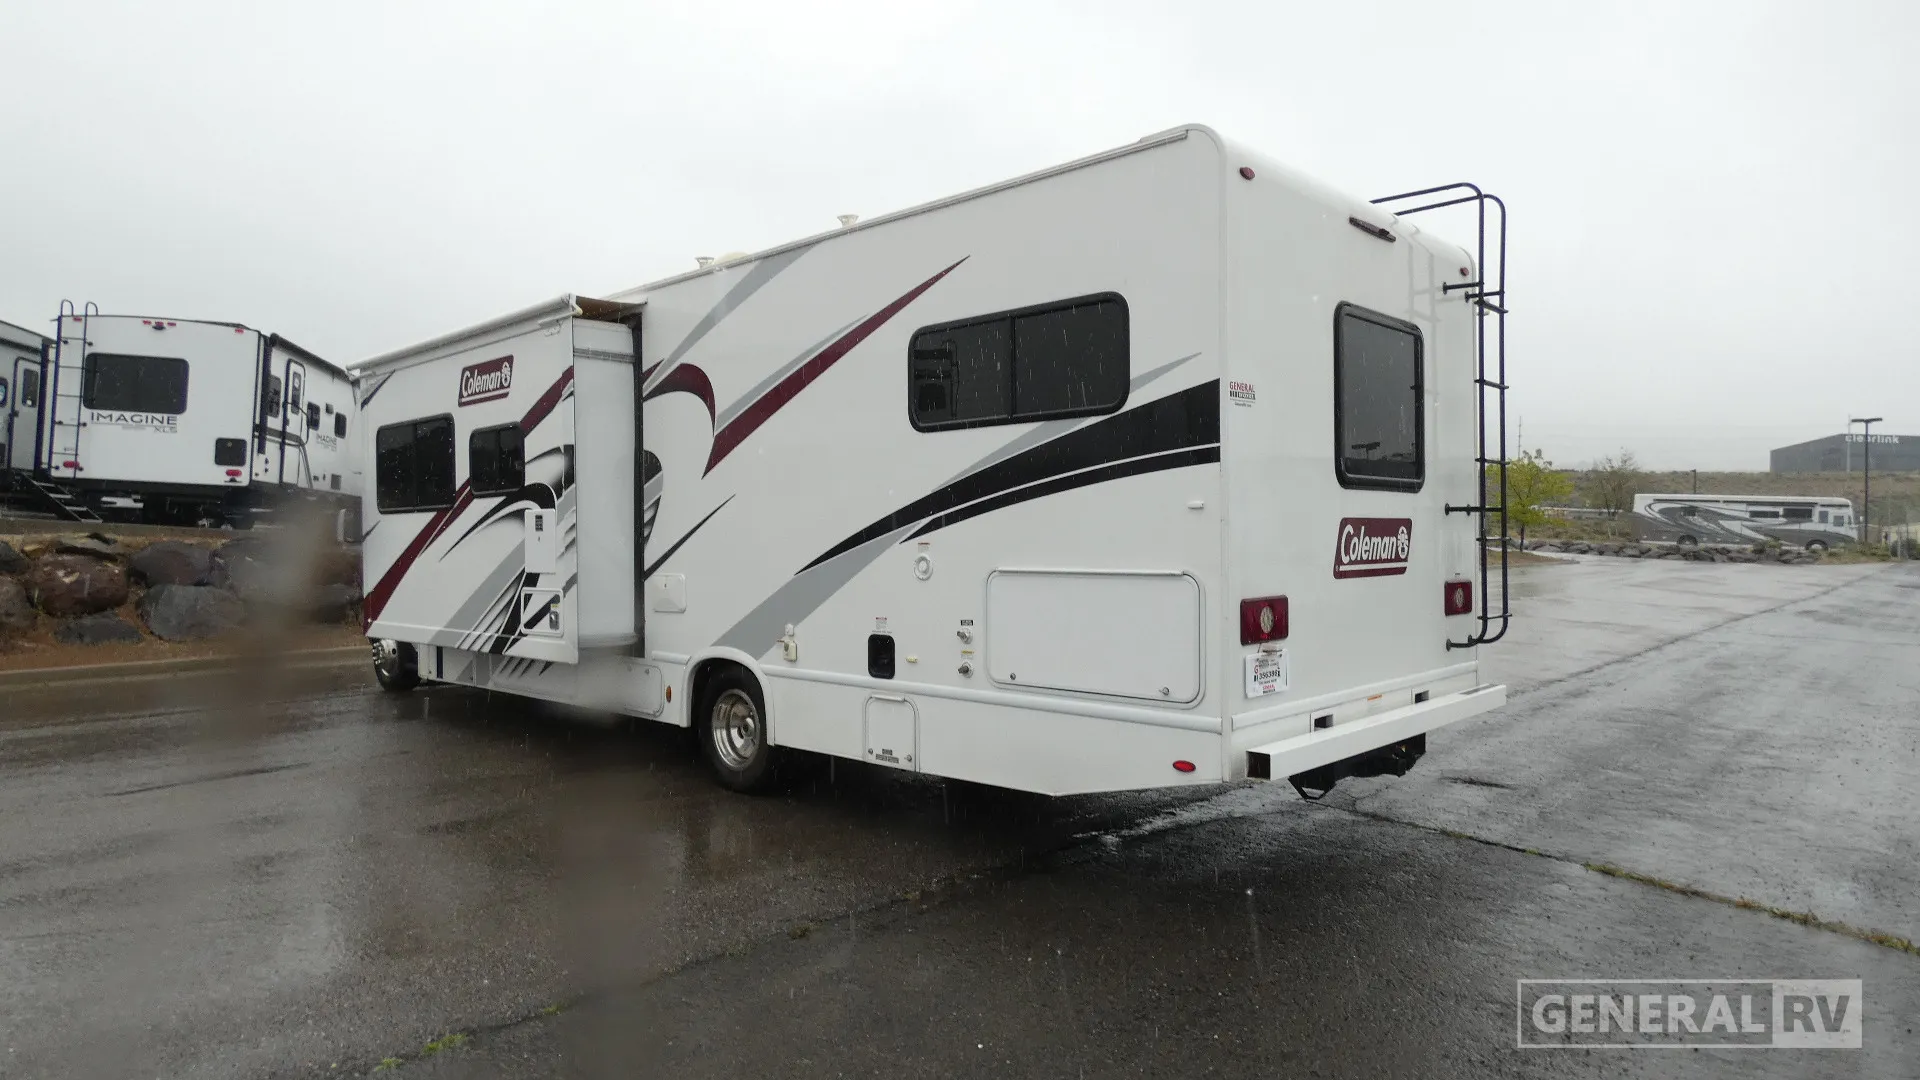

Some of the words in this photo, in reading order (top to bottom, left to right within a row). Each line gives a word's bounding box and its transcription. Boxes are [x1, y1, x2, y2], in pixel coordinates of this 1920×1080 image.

[462, 369, 500, 397] Coleman
[90, 411, 177, 425] IMAGINE
[1341, 524, 1397, 564] Coleman
